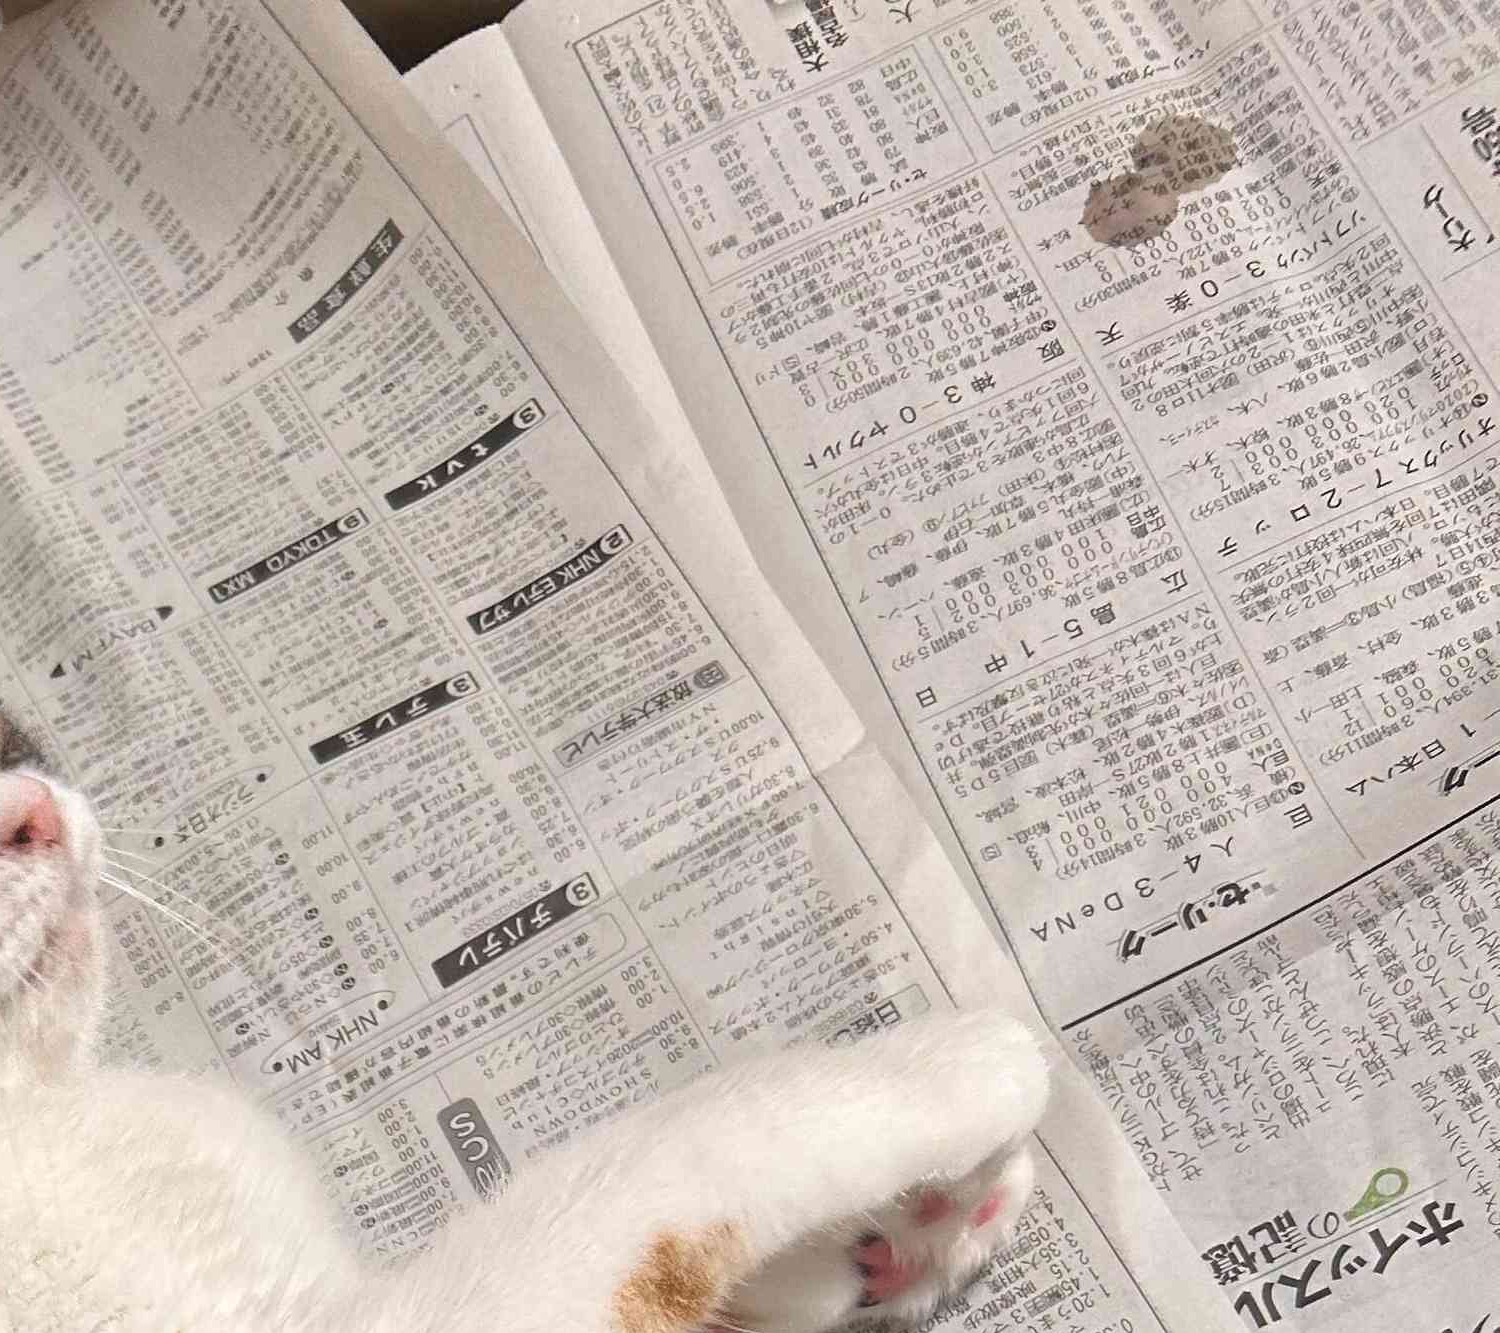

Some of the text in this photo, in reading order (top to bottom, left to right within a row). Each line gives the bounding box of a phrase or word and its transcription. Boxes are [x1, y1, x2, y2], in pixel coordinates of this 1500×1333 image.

[784, 18, 829, 77] 大相撲
[1416, 181, 1477, 255] 大リーグ
[265, 527, 335, 574] TOKYO
[556, 547, 601, 586] NHK
[337, 693, 428, 751] テレ玉
[558, 678, 694, 762] 放送大学テレビ
[454, 901, 553, 971] チバテレ
[284, 1008, 379, 1074] NHK AM
[1339, 1017, 1394, 1088] に現れた。
[1114, 1045, 1202, 1184] せて、ゴールの中へ。
[1195, 1192, 1343, 1289] の記憶
